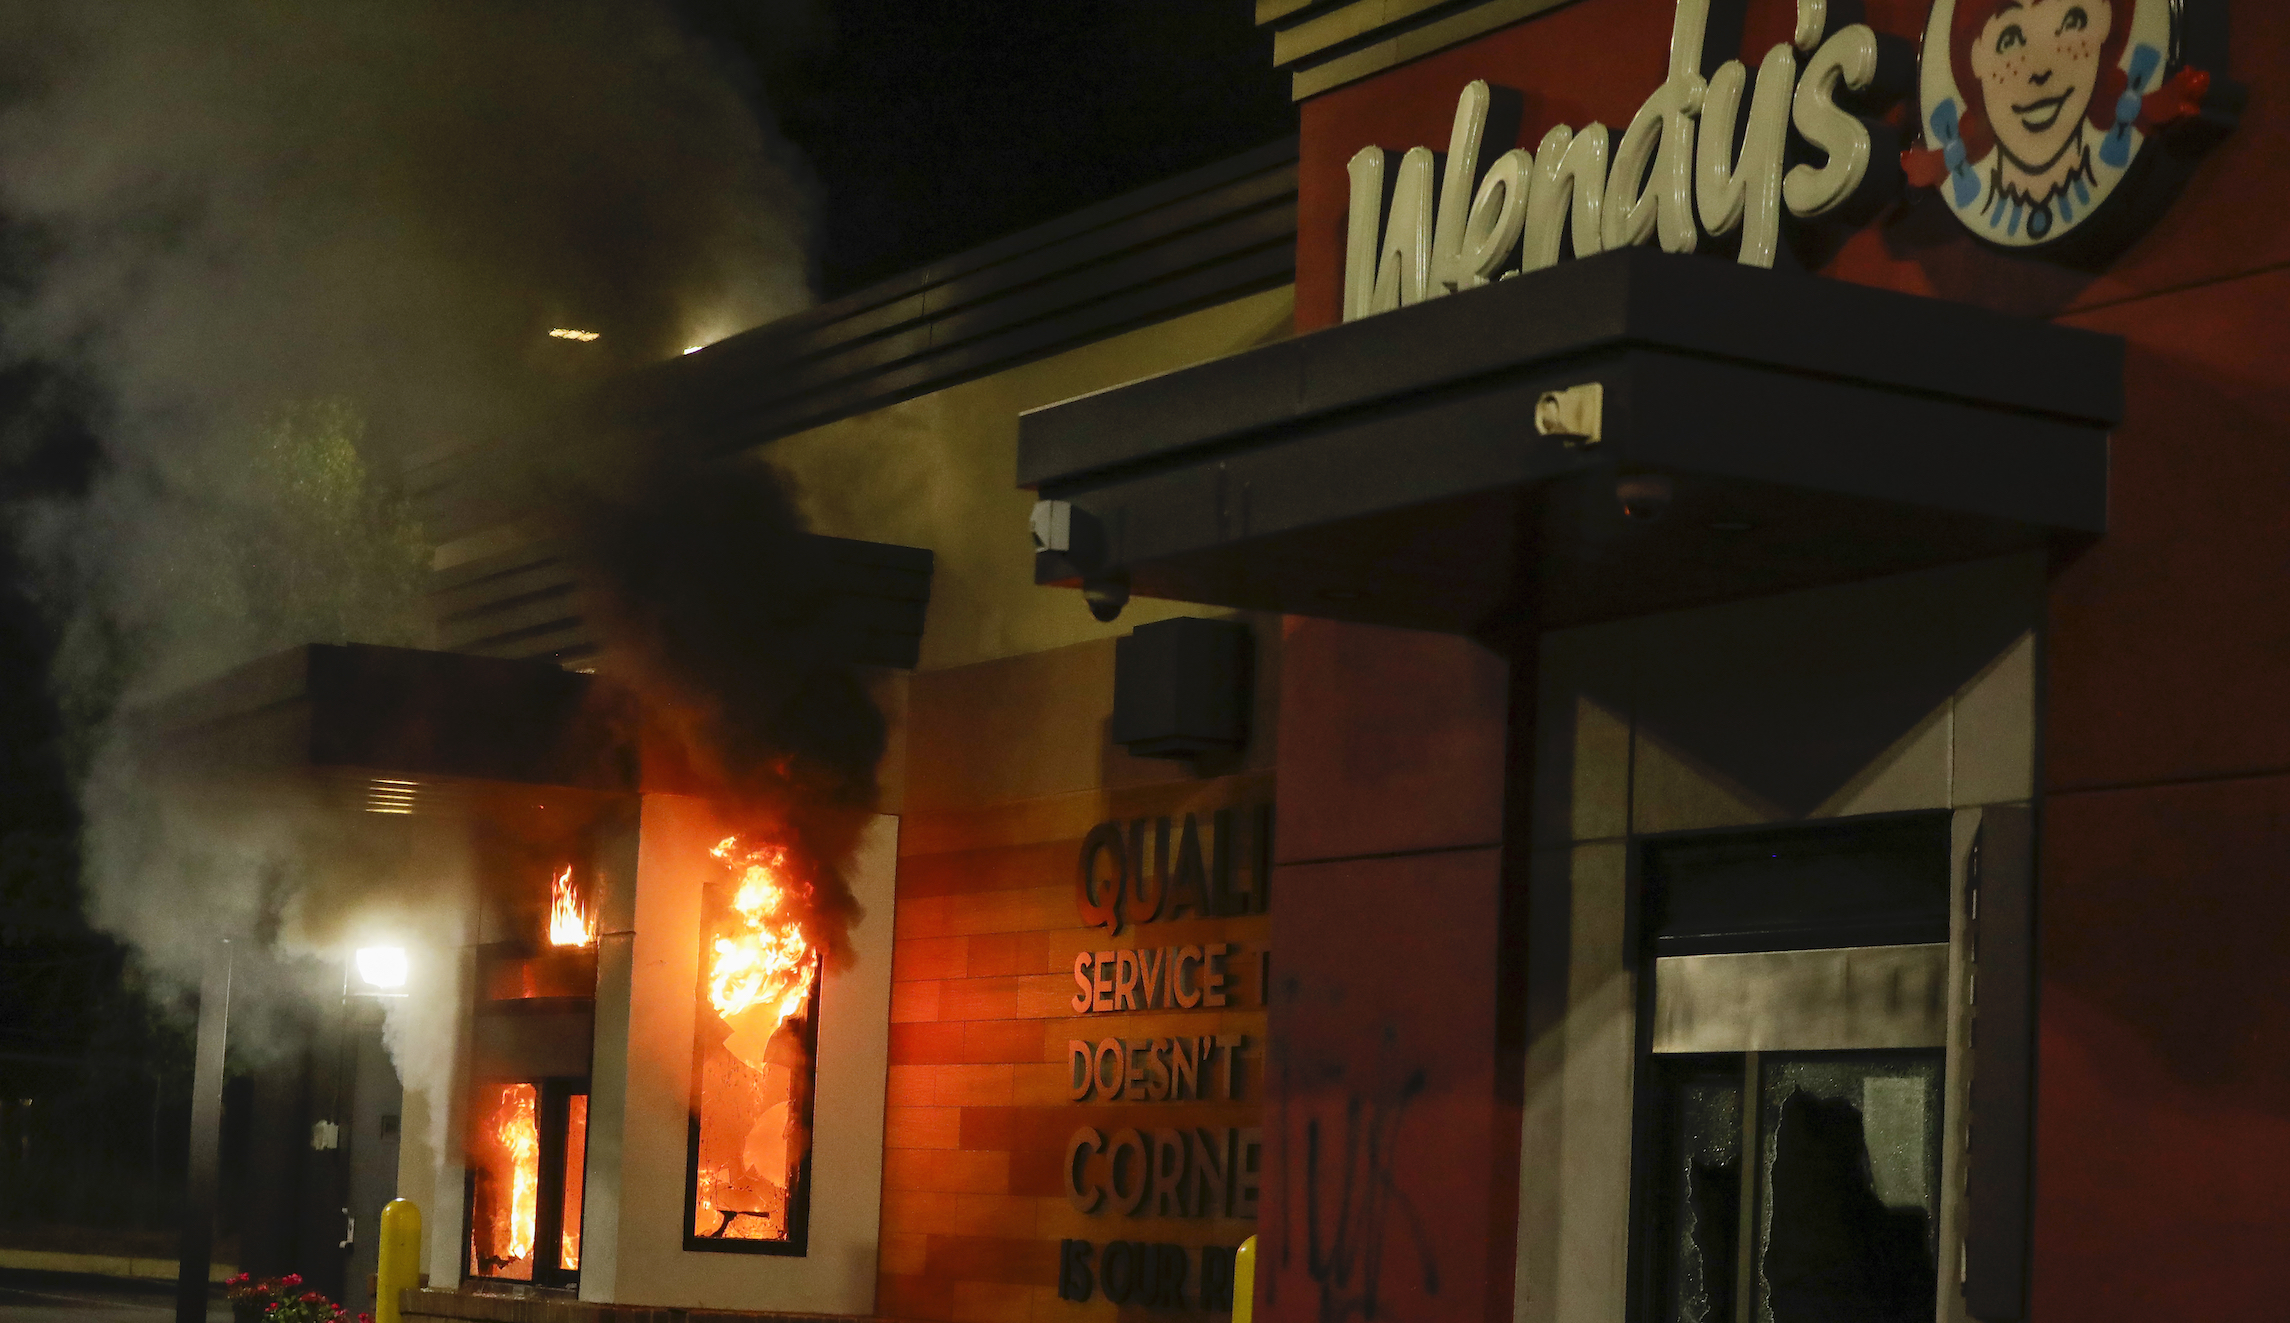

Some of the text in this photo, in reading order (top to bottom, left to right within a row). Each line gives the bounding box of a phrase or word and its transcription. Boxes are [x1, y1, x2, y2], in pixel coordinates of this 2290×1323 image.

[1343, 0, 1878, 323] Wendy's
[1071, 943, 1231, 1013] SERVICE
[1068, 1034, 1246, 1101] DOESN'T
[1058, 1239, 1094, 1302] IS
[1100, 1240, 1188, 1311] OUR
